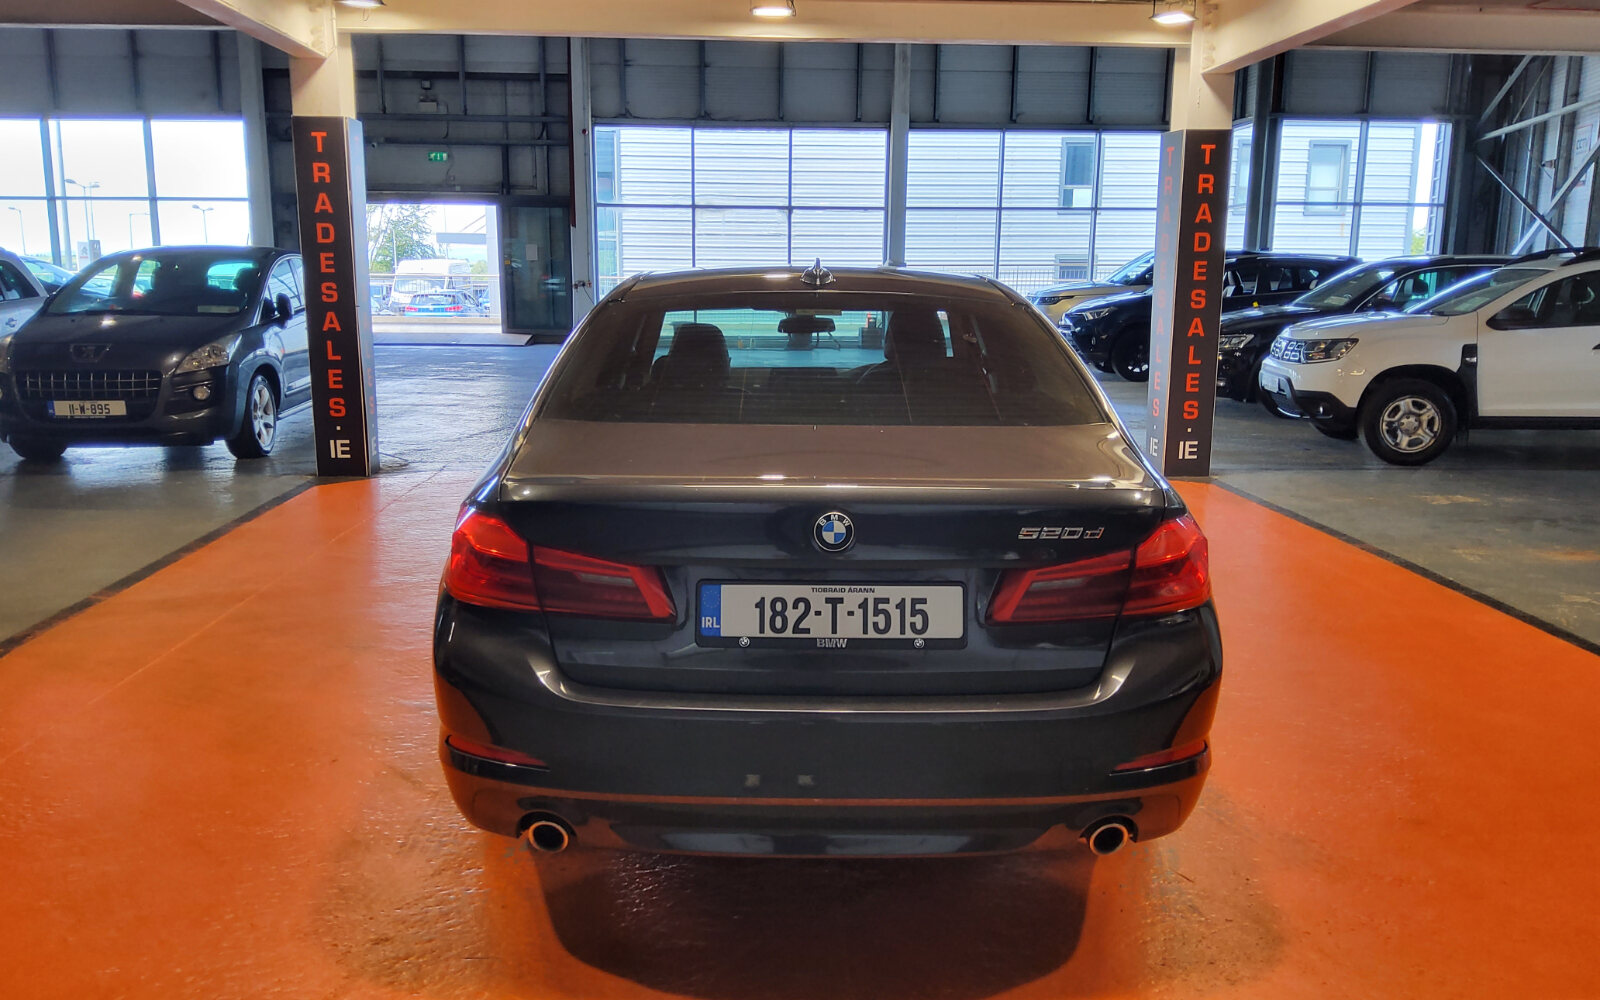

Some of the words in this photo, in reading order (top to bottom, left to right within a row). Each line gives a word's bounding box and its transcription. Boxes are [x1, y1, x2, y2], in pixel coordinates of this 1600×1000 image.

[310, 131, 351, 459] TRADESALES.IE
[1177, 144, 1216, 460] TRADESALES.IE
[68, 403, 111, 415] 11-W-895
[818, 514, 851, 527] BMW
[1018, 527, 1105, 540] 520d
[701, 616, 721, 629] IRL
[754, 596, 930, 636] 182-T-1515
[816, 638, 848, 649] BMW
